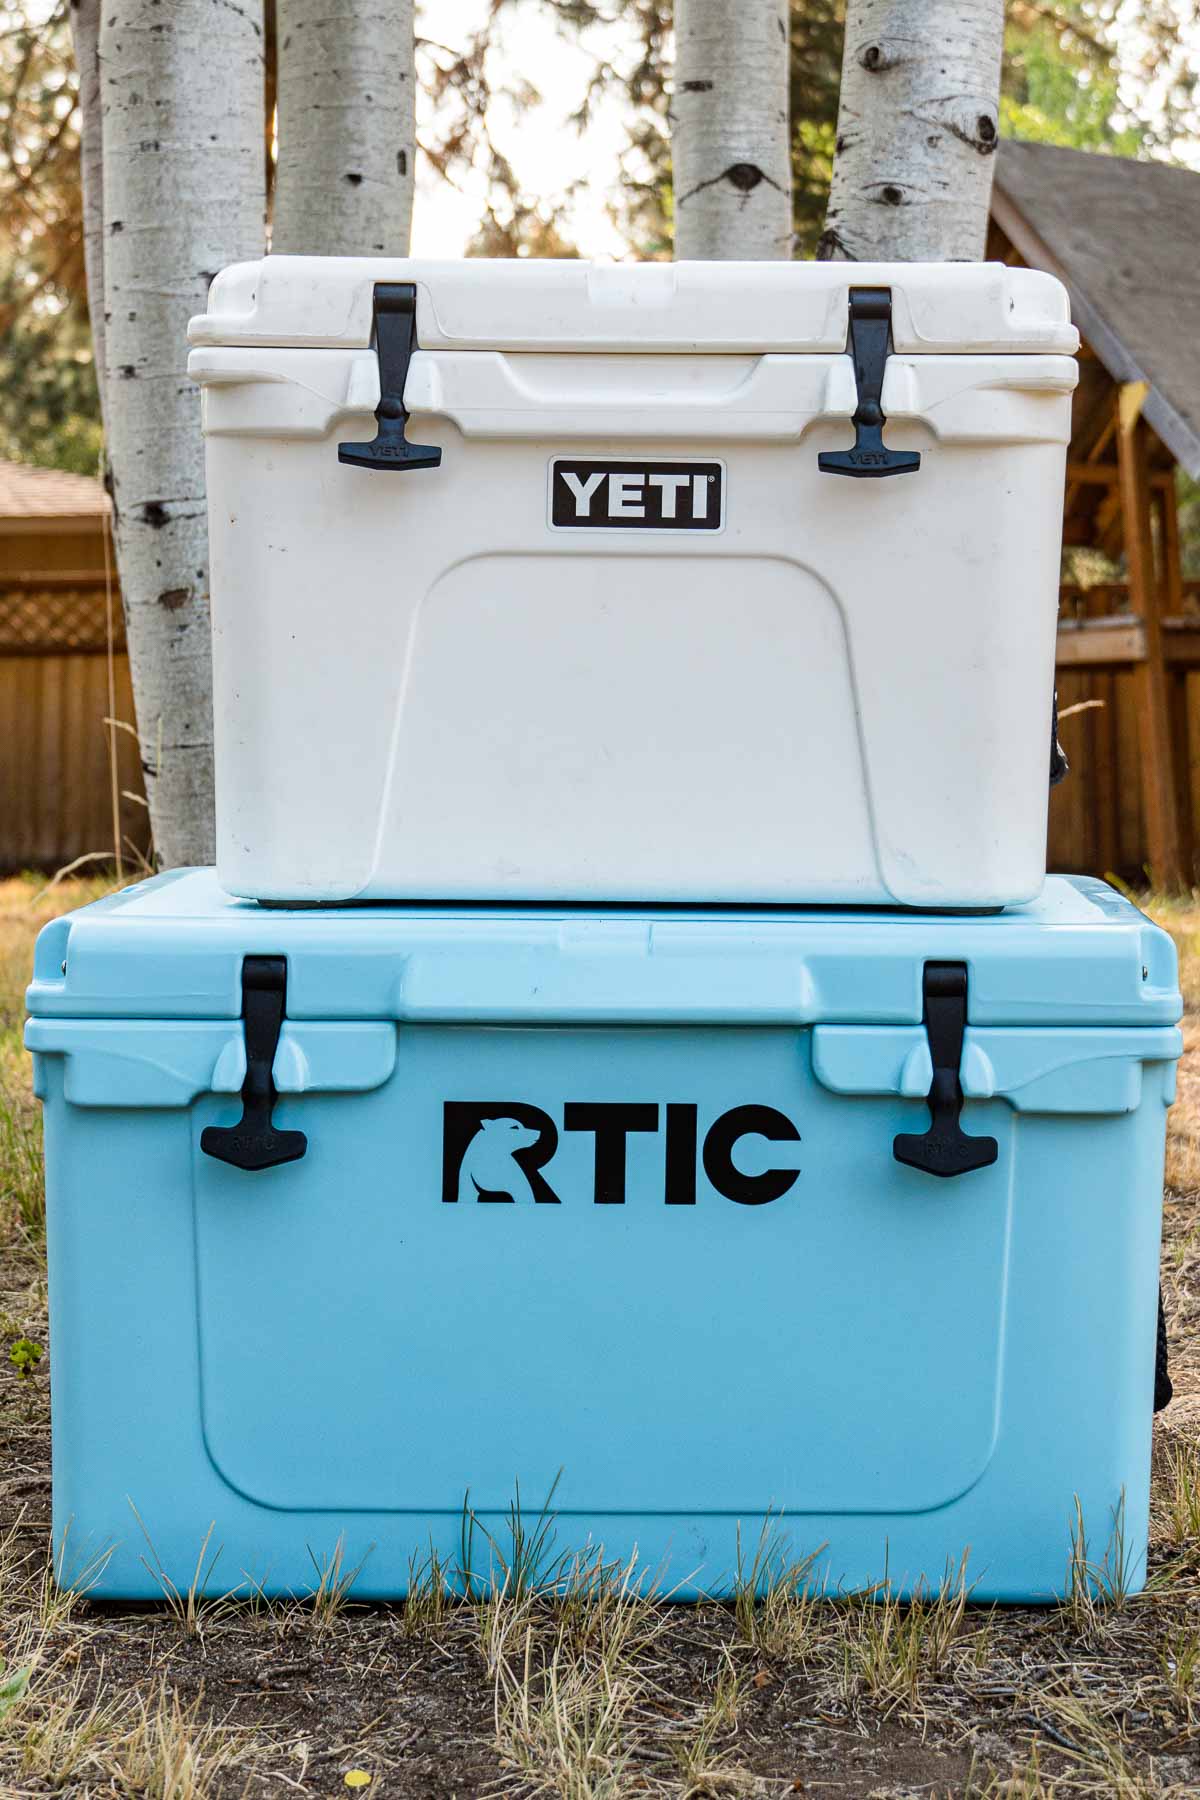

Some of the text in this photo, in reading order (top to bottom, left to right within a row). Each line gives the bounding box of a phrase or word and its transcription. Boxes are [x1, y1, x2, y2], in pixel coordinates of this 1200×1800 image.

[368, 445, 409, 458] YETI
[847, 453, 889, 465] YETI
[442, 1101, 801, 1205] RTIC
